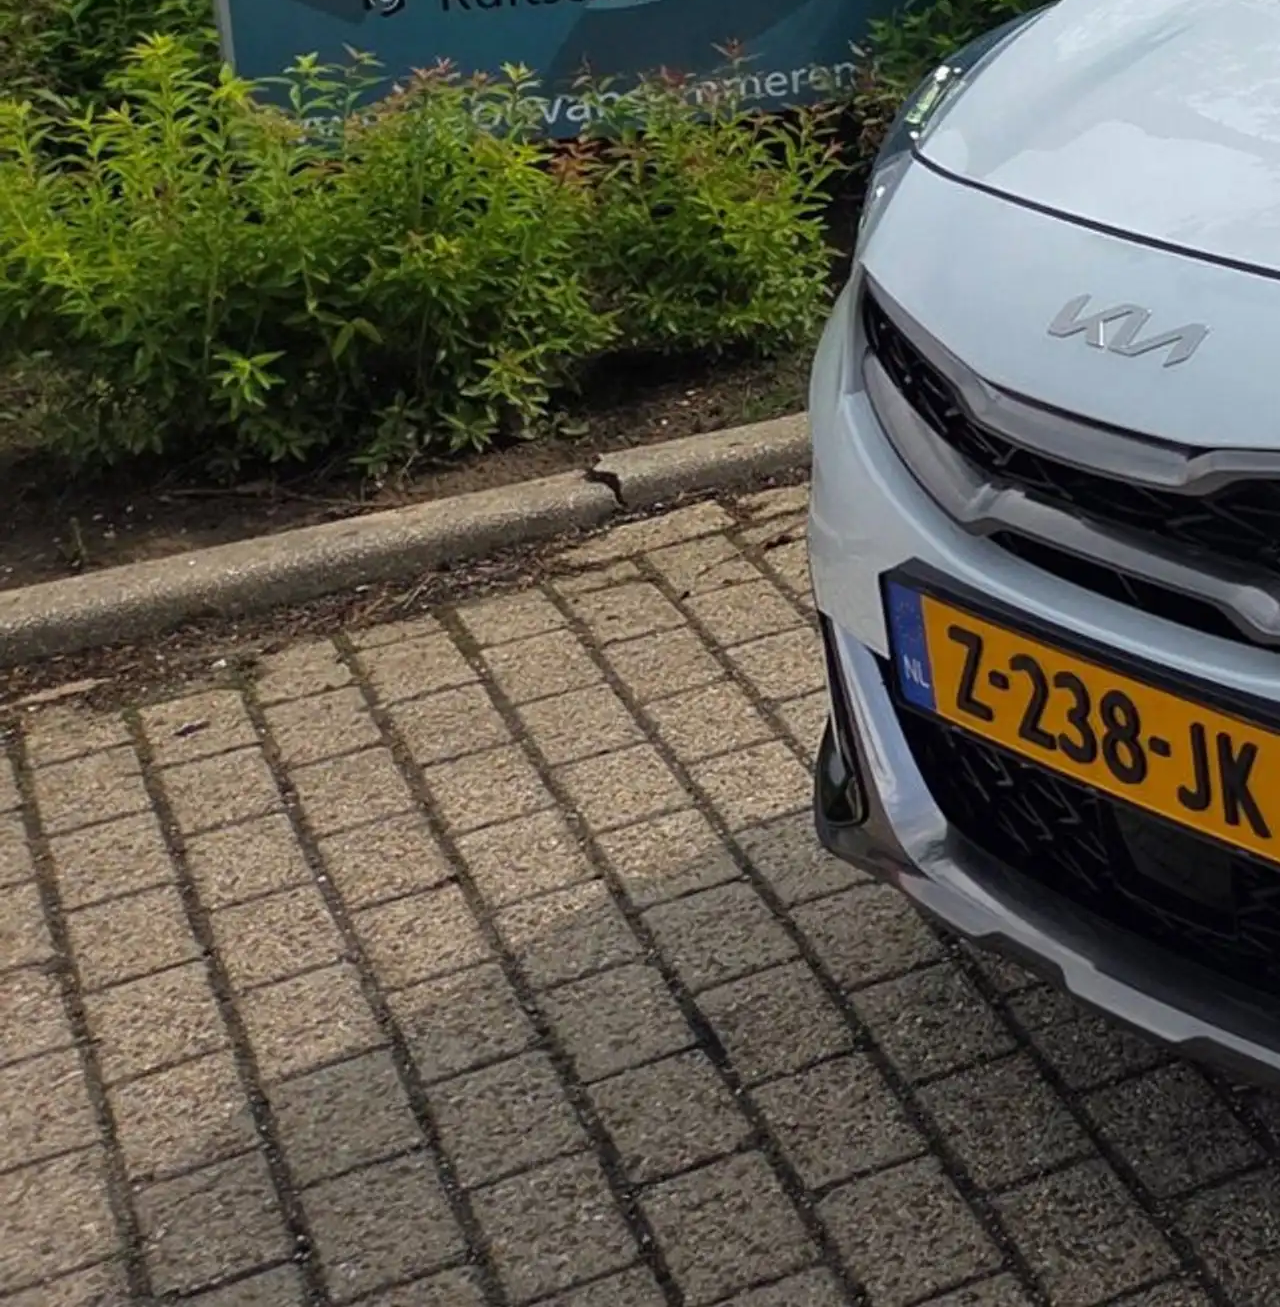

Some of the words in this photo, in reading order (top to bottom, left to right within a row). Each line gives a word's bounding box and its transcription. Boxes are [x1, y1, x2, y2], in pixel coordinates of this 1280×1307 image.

[1047, 294, 1211, 368] KIA
[903, 654, 931, 690] NL
[947, 623, 1272, 840] Z-238-JK
